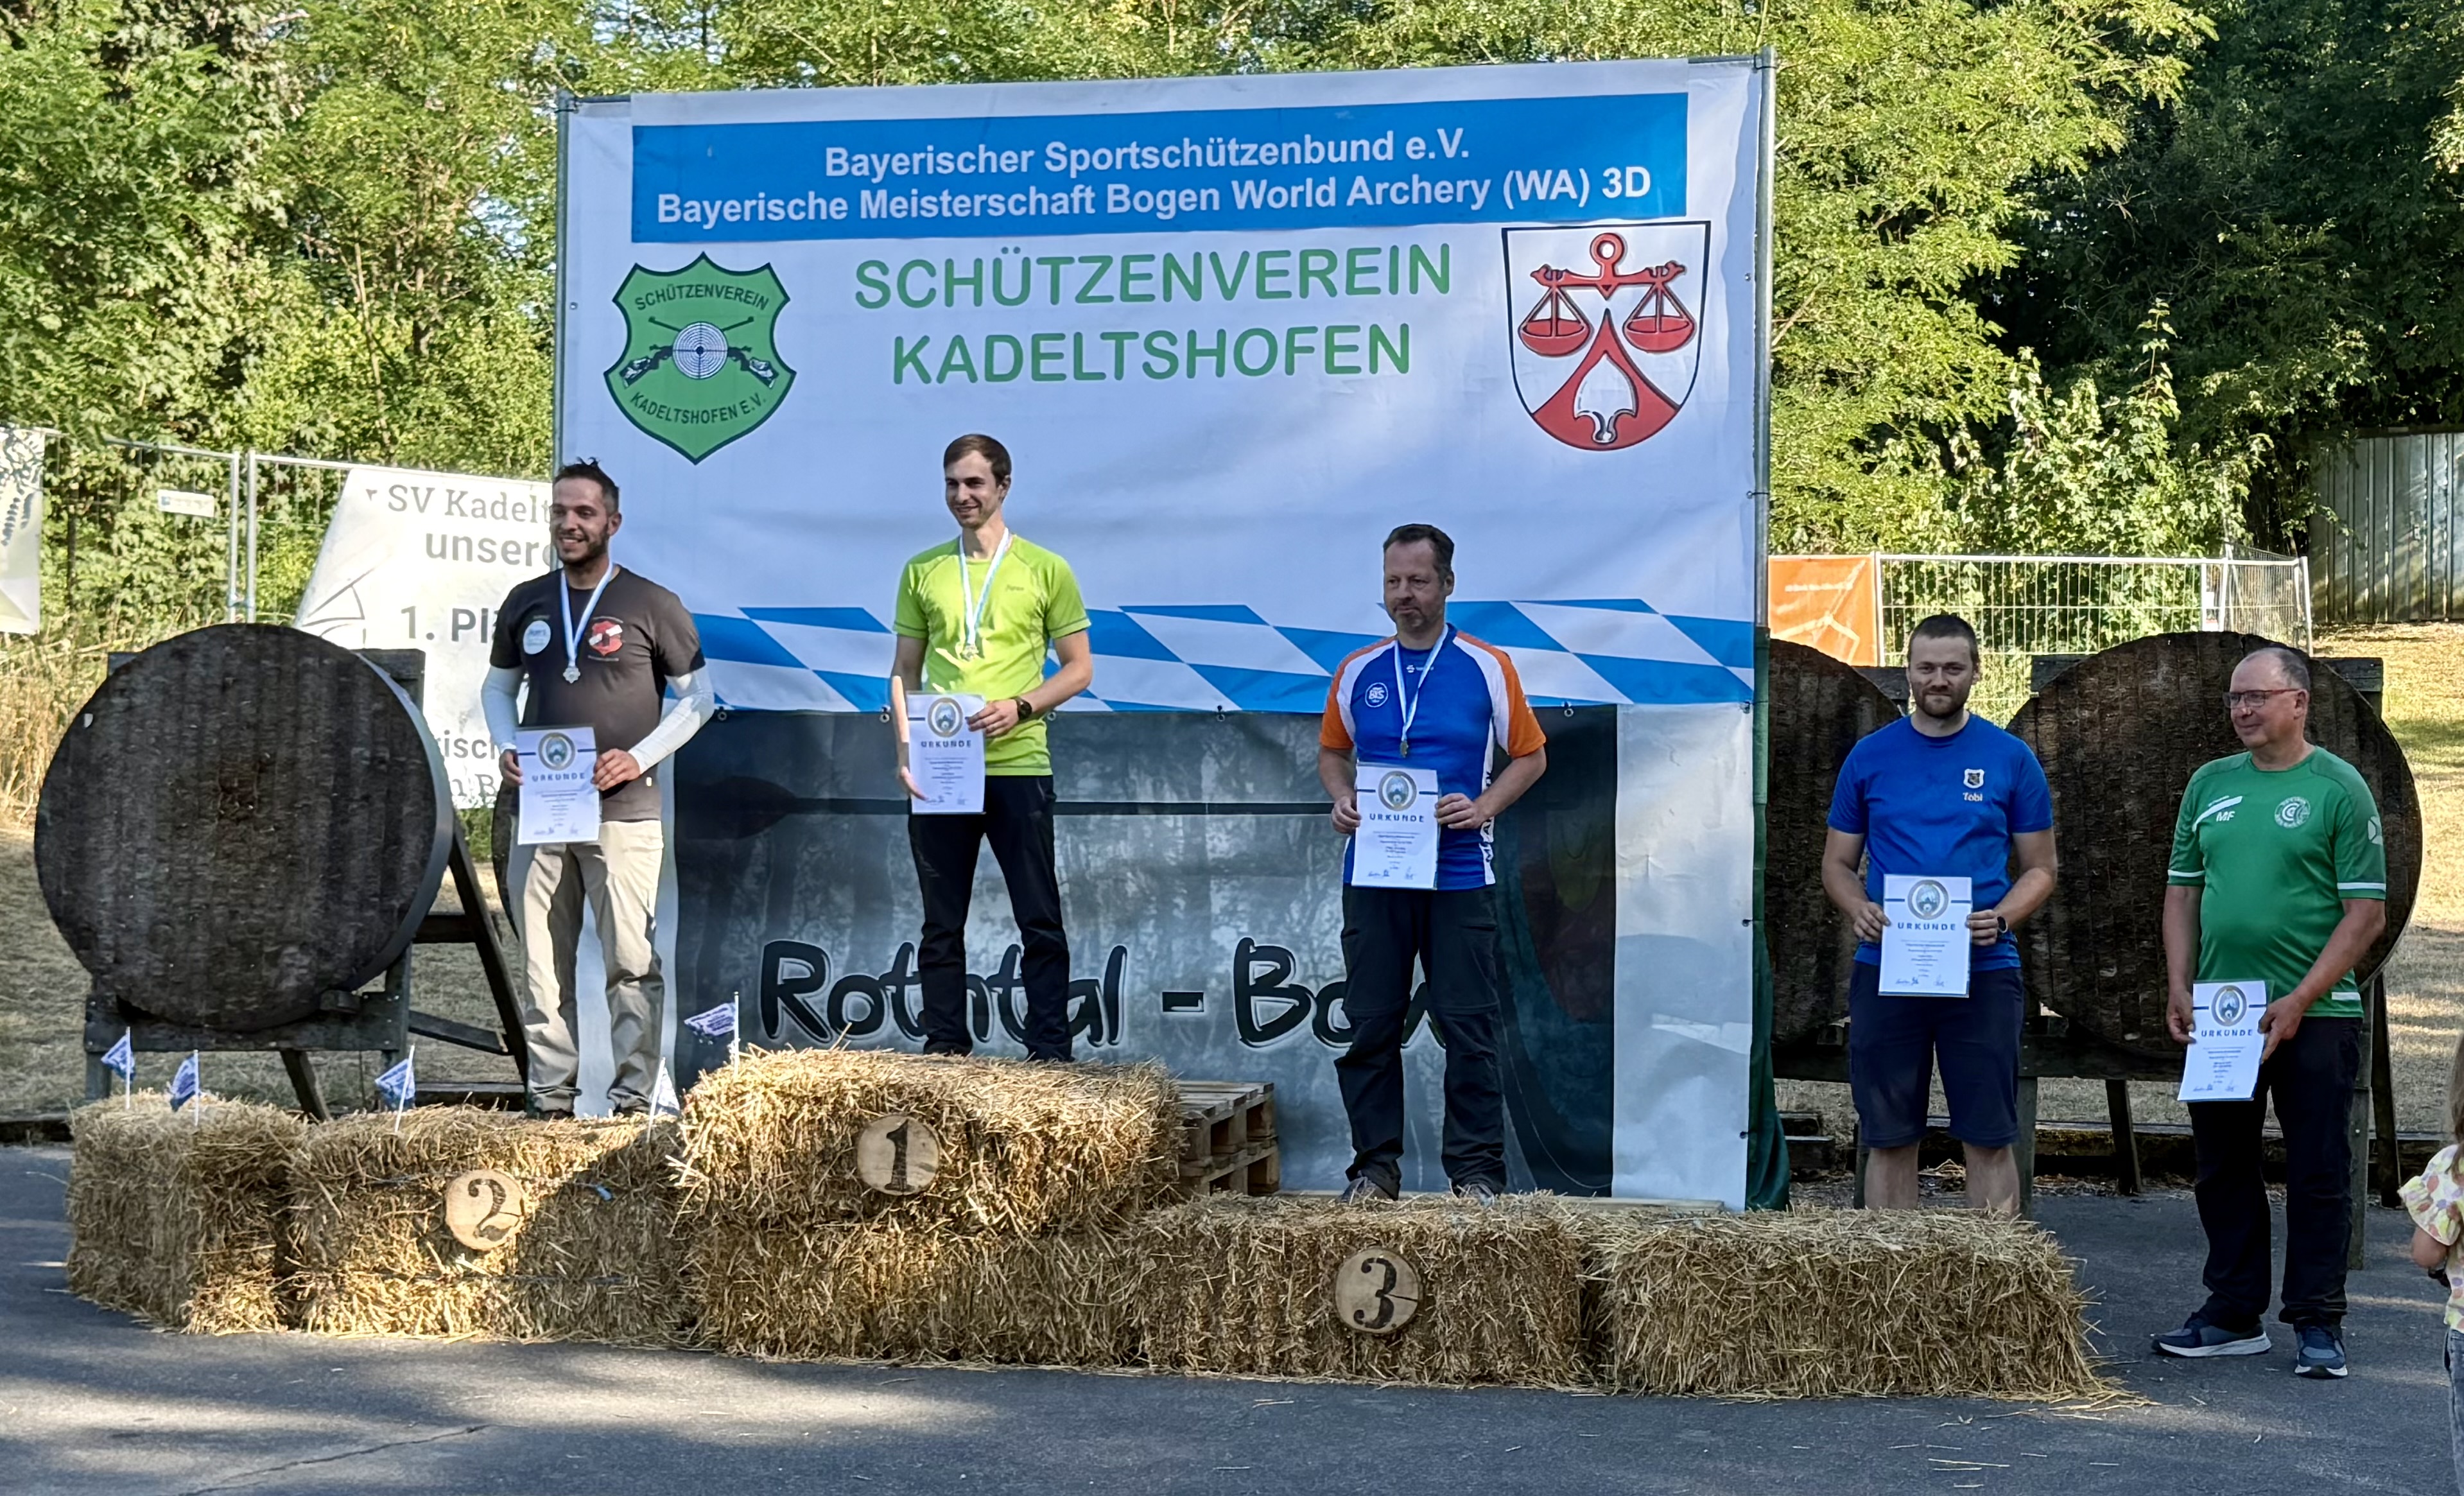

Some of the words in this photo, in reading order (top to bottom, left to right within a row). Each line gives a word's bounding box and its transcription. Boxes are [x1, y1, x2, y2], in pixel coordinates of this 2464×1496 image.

[826, 144, 1034, 183] Bayerischer
[1044, 130, 1394, 178] Sportschützenbund
[1405, 128, 1469, 160] e.V.
[658, 191, 848, 229] Bayerische
[860, 184, 1095, 219] Meisterschaft
[1107, 183, 1220, 220] Bogen
[1231, 177, 1336, 210] World
[1346, 174, 1491, 210] Archery
[1504, 168, 1590, 209] (WA)
[1602, 166, 1651, 198] 3D
[855, 242, 1450, 309] SCHÜTZENVEREIN
[634, 283, 769, 311] SCHÜTZENVEREIN
[893, 322, 1409, 385] KADELTSHOFEN
[630, 392, 738, 424] KADELTSHOFEN
[740, 393, 767, 415] E.V.
[388, 484, 435, 514] SV
[401, 605, 435, 641] 1.
[451, 607, 501, 643] Pl
[921, 740, 971, 748] URKUNDE
[531, 772, 586, 783] URKUNDE
[1369, 813, 1424, 822] URKUNDE
[2216, 811, 2235, 822] MF
[1897, 922, 1956, 931] URKUNDE
[2201, 1029, 2253, 1038] URKUNDE
[885, 1119, 915, 1192] 1
[467, 1179, 513, 1242] 2
[1353, 1258, 1397, 1329] 3
